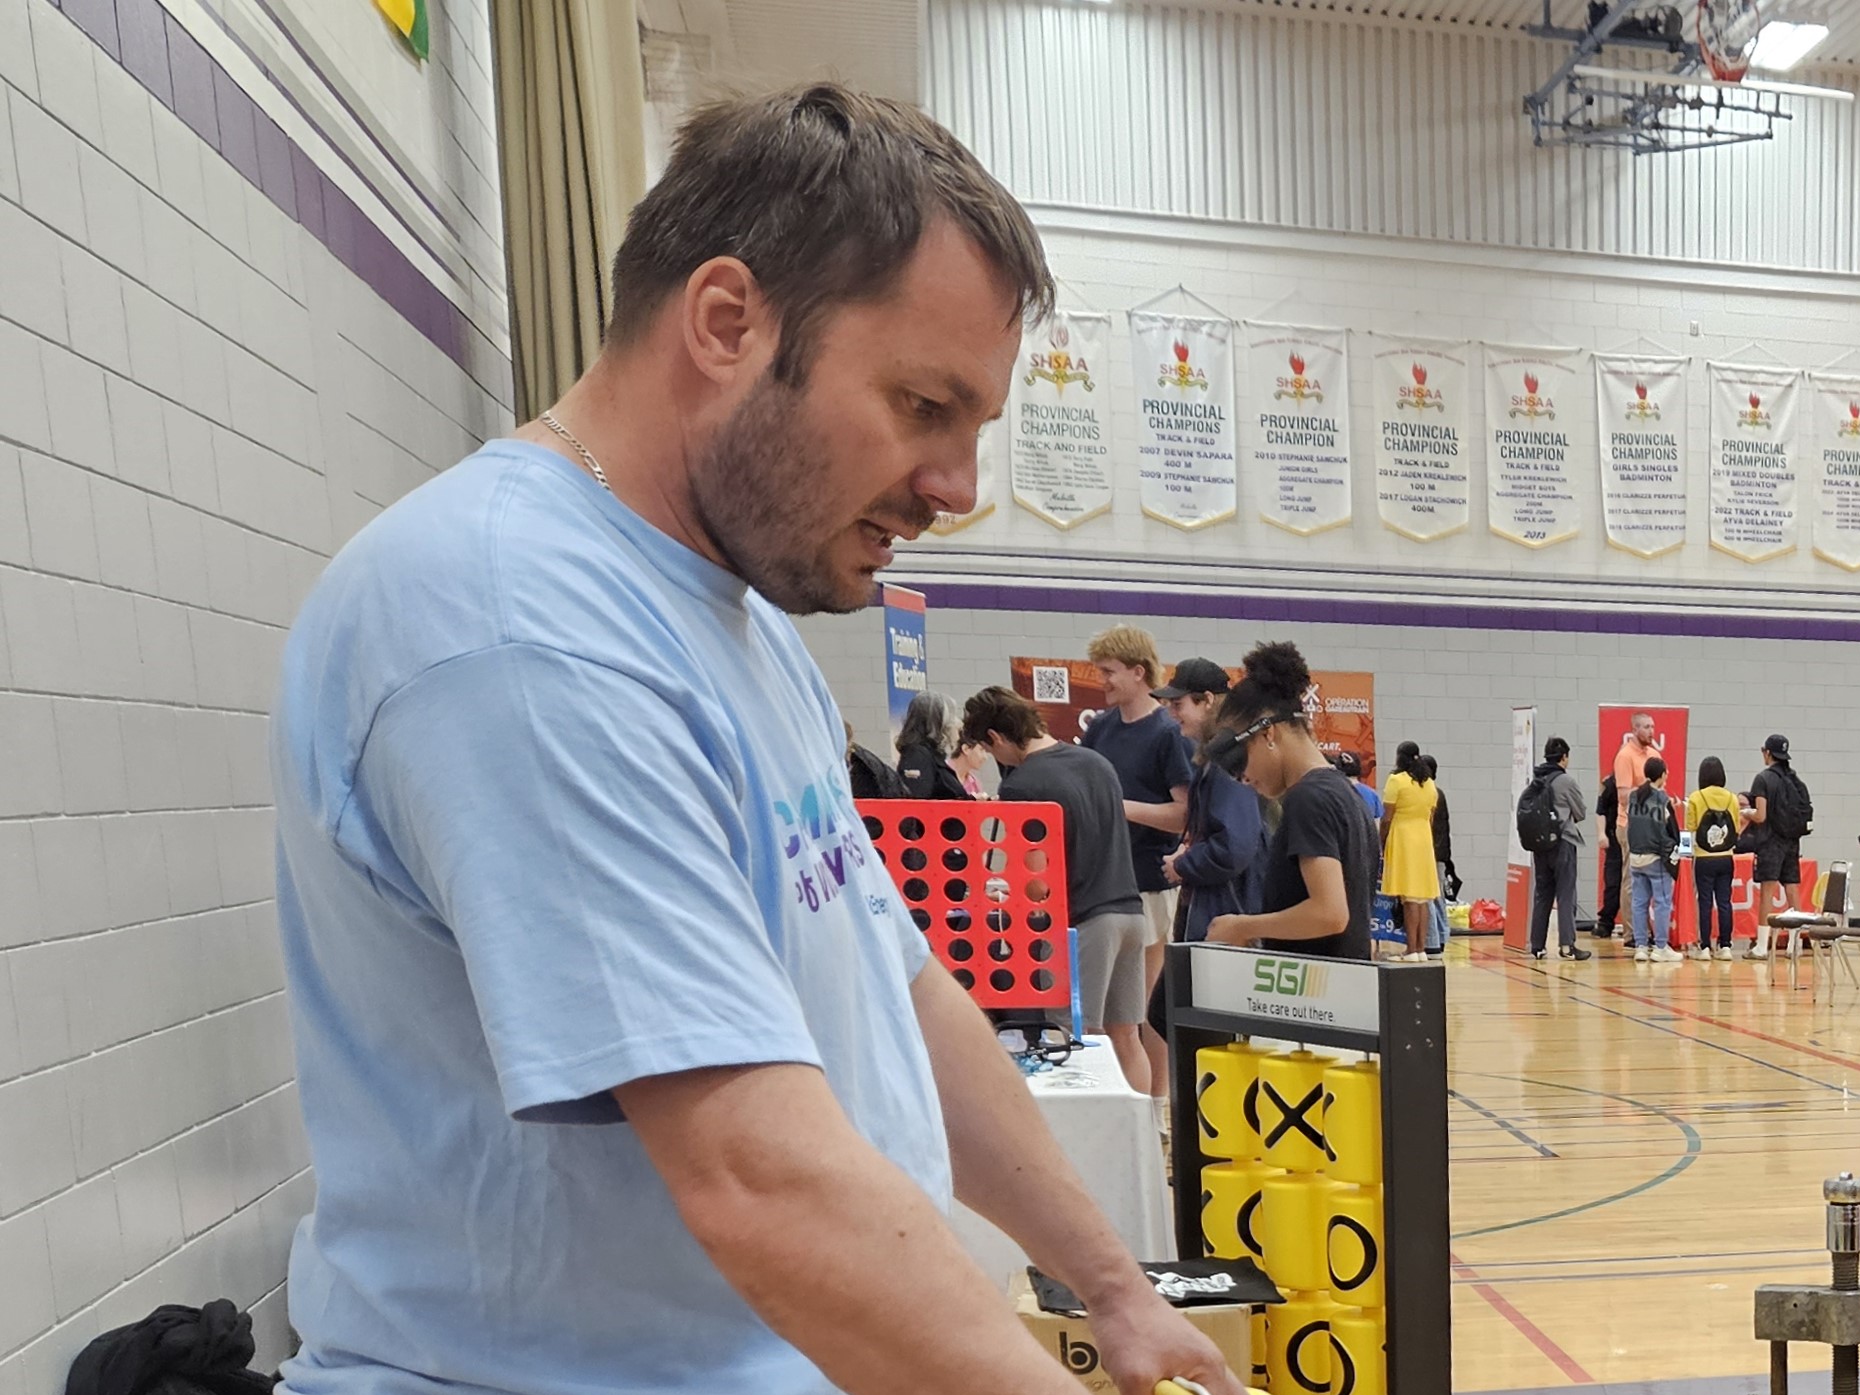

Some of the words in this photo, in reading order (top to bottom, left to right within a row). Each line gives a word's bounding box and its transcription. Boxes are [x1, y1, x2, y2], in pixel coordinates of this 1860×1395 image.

[1030, 353, 1088, 372] SHSAA
[1160, 364, 1205, 378] SHSAA
[1276, 376, 1321, 390] SHSAA
[1399, 386, 1442, 399] SHSAA
[1511, 395, 1554, 408] SHSAA
[1626, 401, 1660, 410] SHSAA
[1021, 403, 1099, 423] PROVINCIAL
[1142, 399, 1226, 420] PROVINCIAL
[1739, 410, 1771, 420] SHSAA
[1149, 416, 1221, 434] CHAMPIONS
[1260, 413, 1339, 432] PROVINCIAL
[1021, 420, 1100, 440] CHAMPIONS
[1382, 421, 1459, 441] PROVINCIAL
[1156, 433, 1183, 442] TRACK
[1194, 437, 1215, 446] FIELD
[1267, 430, 1334, 447] CHAMPION
[1495, 429, 1570, 447] PROVINCIAL
[1611, 432, 1677, 446] PROVINCIAL
[1016, 439, 1051, 451] TRACK
[1054, 442, 1075, 453] AND
[1078, 445, 1107, 455] FIELD
[1139, 446, 1160, 455] 2007
[1164, 448, 1194, 458] DEVIN
[1384, 437, 1458, 456] CHAMPIONS
[1500, 445, 1565, 461] CHAMPION
[1611, 446, 1678, 461] CHAMPIONS
[1722, 439, 1786, 455] PROVINCIAL
[1254, 451, 1276, 459] 2010
[1722, 453, 1787, 469] CHAMPIONS
[1164, 460, 1181, 468] 400
[1393, 458, 1419, 466] TRACK
[1429, 460, 1449, 468] FIELD
[1506, 462, 1530, 470] TRACK
[1612, 464, 1638, 472] GIRLS
[1641, 464, 1678, 472] SINGLES
[1139, 470, 1161, 479] 2009
[1378, 468, 1399, 477] 2012
[1732, 470, 1757, 478] MIXED
[1759, 472, 1795, 480] DOUBLES
[1165, 484, 1181, 492] 100
[1184, 485, 1192, 493] M
[1410, 483, 1425, 491] 100
[1730, 480, 1777, 488] BADMINTON
[1822, 479, 1851, 487] TRACK
[1411, 505, 1435, 513] 400M
[1735, 508, 1760, 516] TRACK
[1771, 510, 1793, 518] FIELD
[889, 627, 919, 665] Training
[892, 661, 926, 691] Education
[1316, 742, 1341, 751] CART.
[1253, 958, 1308, 996] SGI
[1247, 997, 1268, 1013] Take
[1270, 1003, 1289, 1016] care
[1292, 1005, 1307, 1018] out
